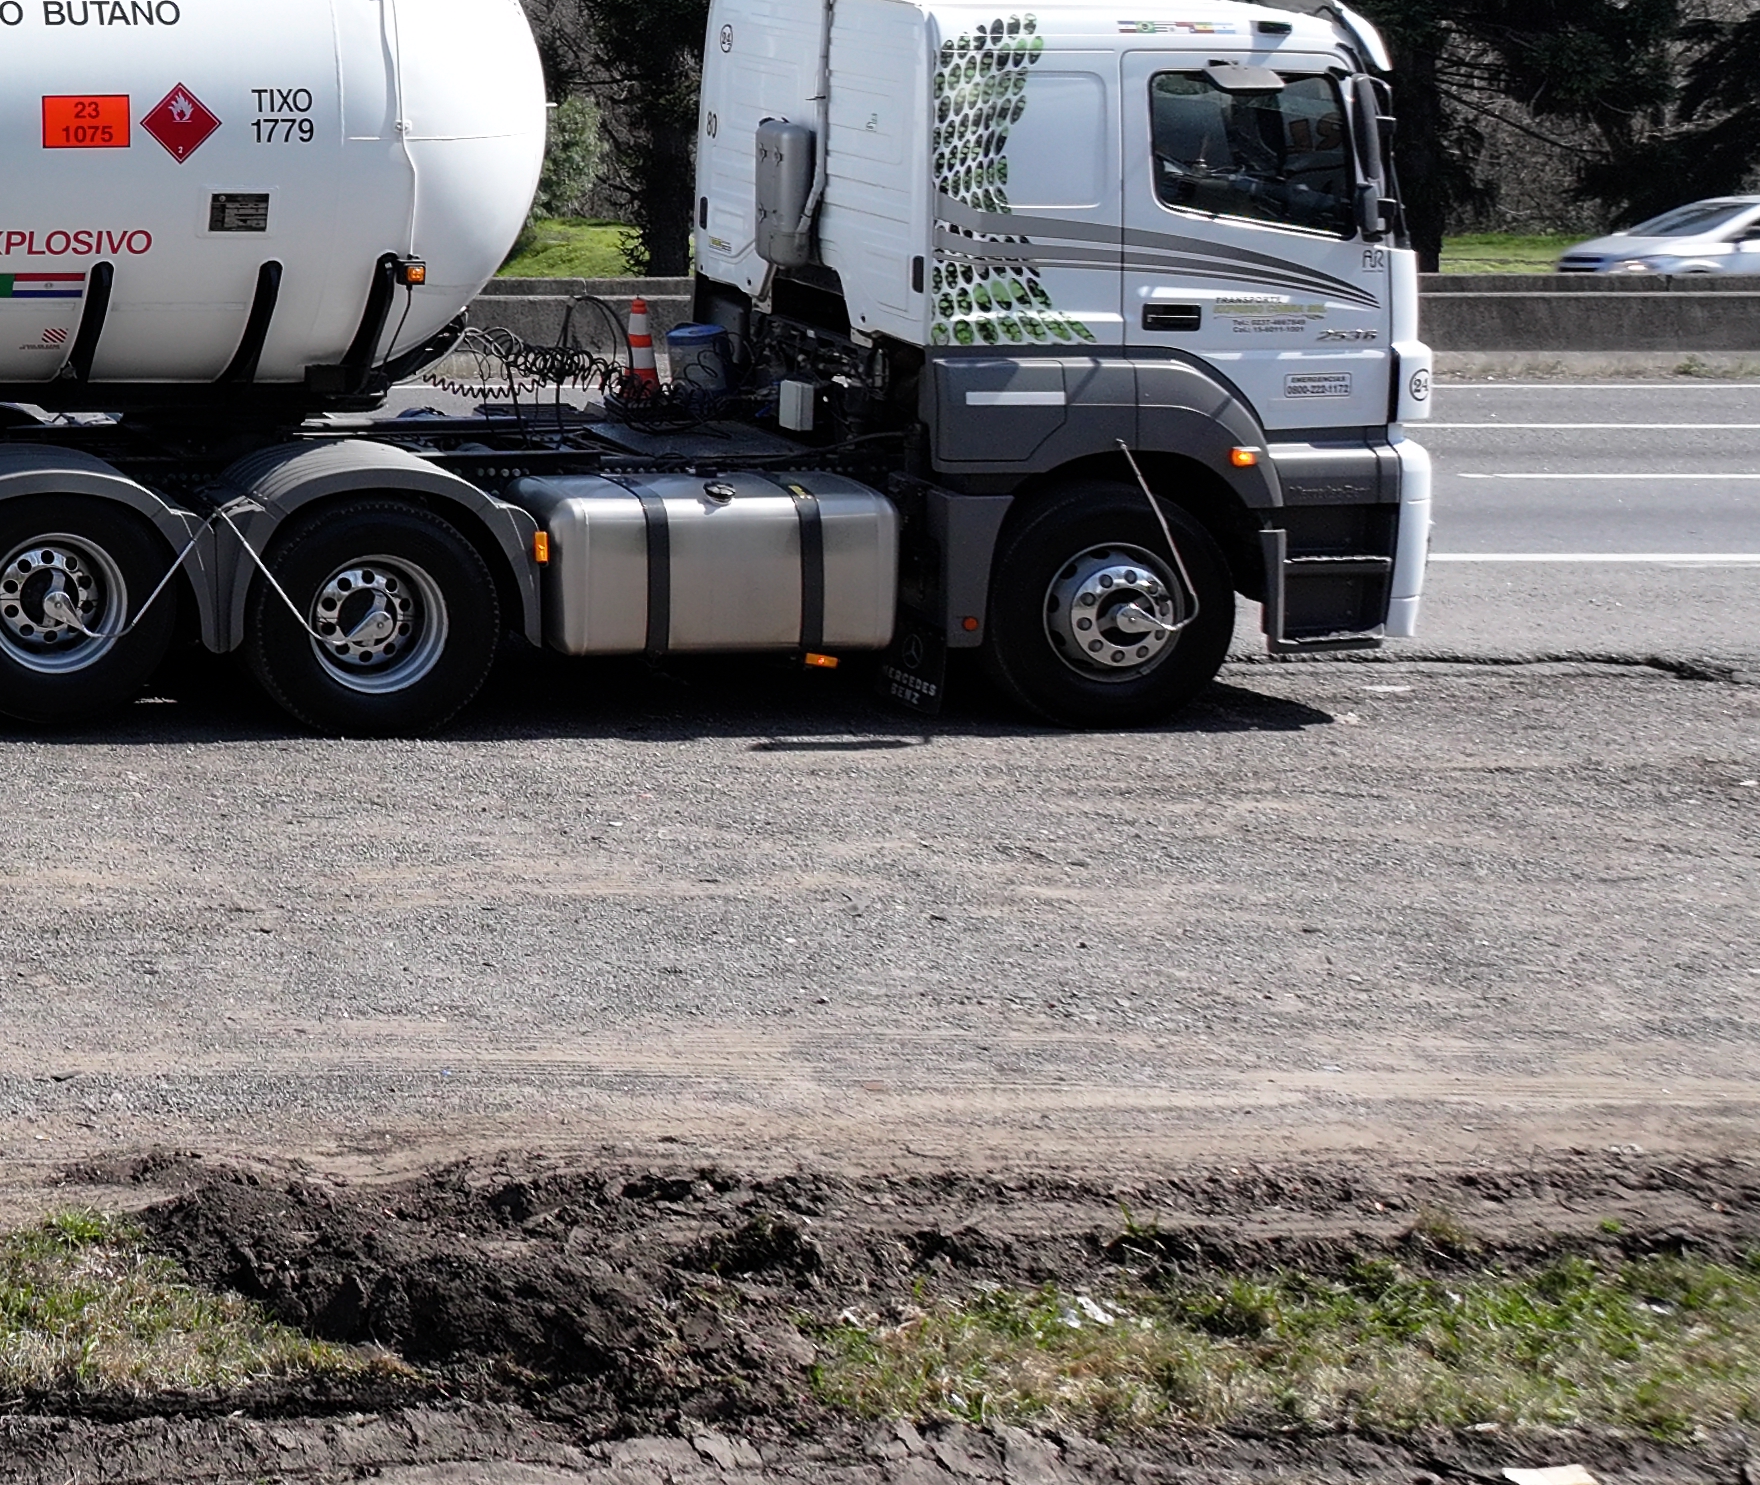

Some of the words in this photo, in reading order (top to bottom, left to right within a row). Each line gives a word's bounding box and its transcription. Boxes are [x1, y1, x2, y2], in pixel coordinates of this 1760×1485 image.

[42, 0, 181, 26] BUTANO
[73, 101, 100, 120] 23
[251, 88, 313, 113] TIXO
[61, 125, 114, 144] 1075
[251, 118, 314, 143] 1779
[706, 111, 718, 139] 80
[1316, 328, 1378, 341] 2536
[891, 682, 920, 705] BENZ
